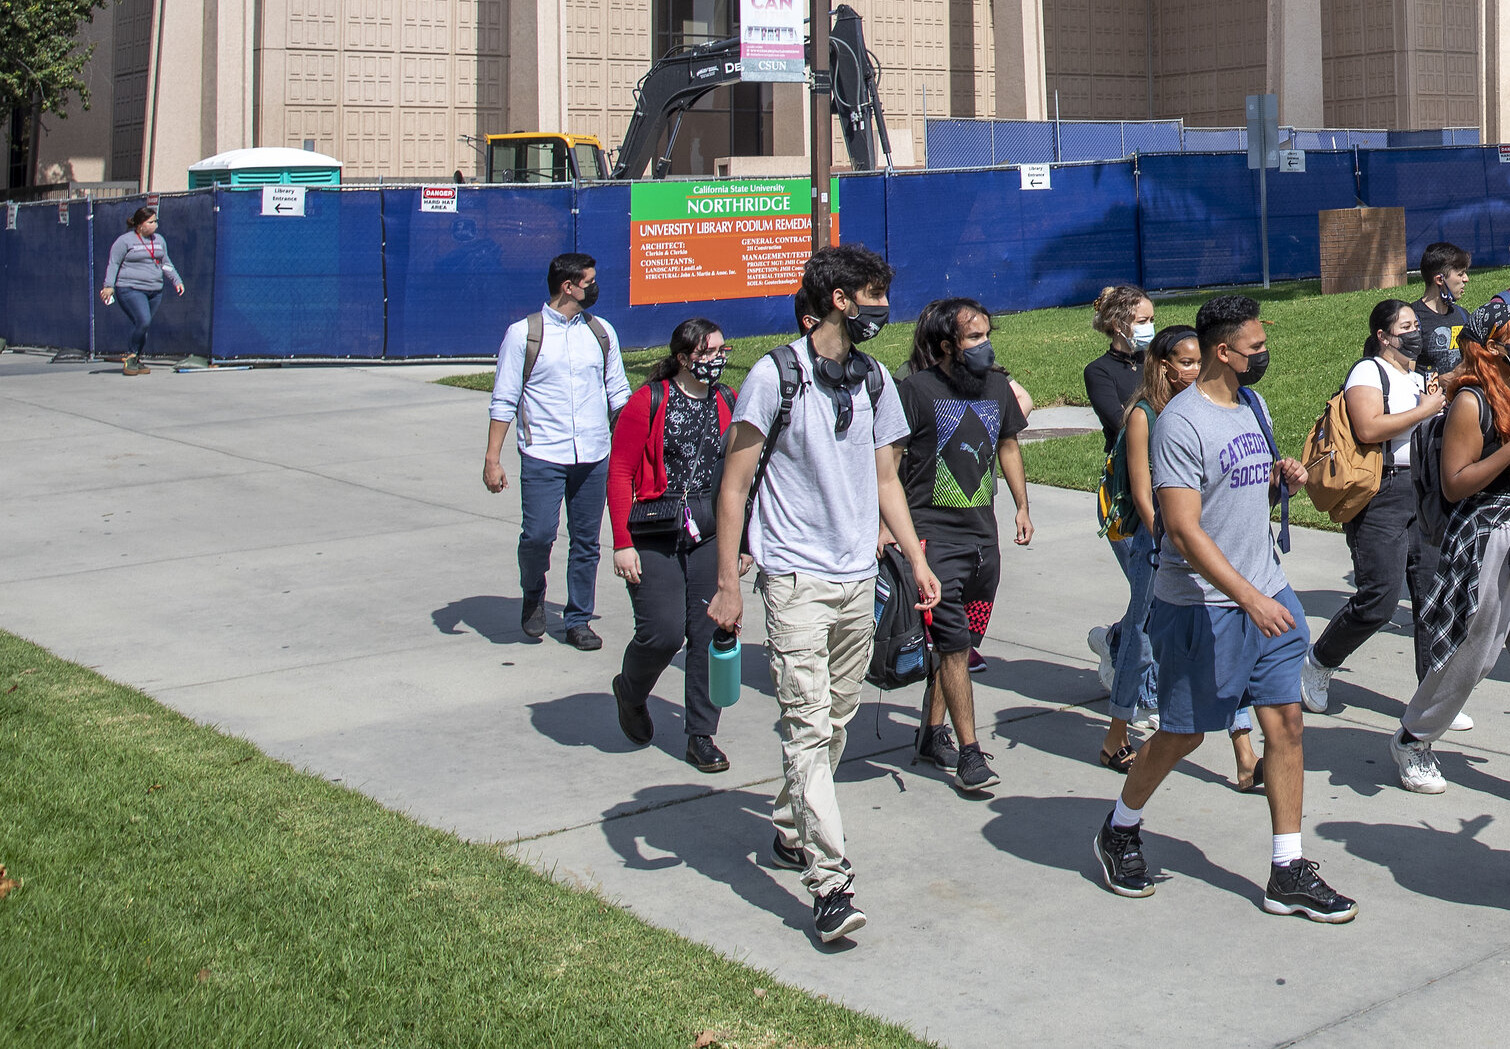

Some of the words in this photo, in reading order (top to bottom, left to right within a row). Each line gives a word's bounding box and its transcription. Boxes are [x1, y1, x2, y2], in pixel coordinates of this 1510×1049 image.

[724, 62, 742, 74] DE
[758, 61, 787, 70] CSUN
[693, 185, 729, 194] California
[730, 184, 748, 193] State
[750, 183, 785, 193] University
[687, 196, 791, 214] NORTHRIDGE
[639, 222, 695, 237] UNIVERSITY
[696, 220, 734, 235] LIBRARY
[735, 219, 773, 233] PODIUM
[640, 241, 685, 251] ARCHITECT:
[741, 237, 774, 246] GENERAL
[775, 235, 812, 244] CONTRACT
[640, 257, 695, 267] CONSULTANTS:
[1219, 432, 1269, 474] CATHEDR
